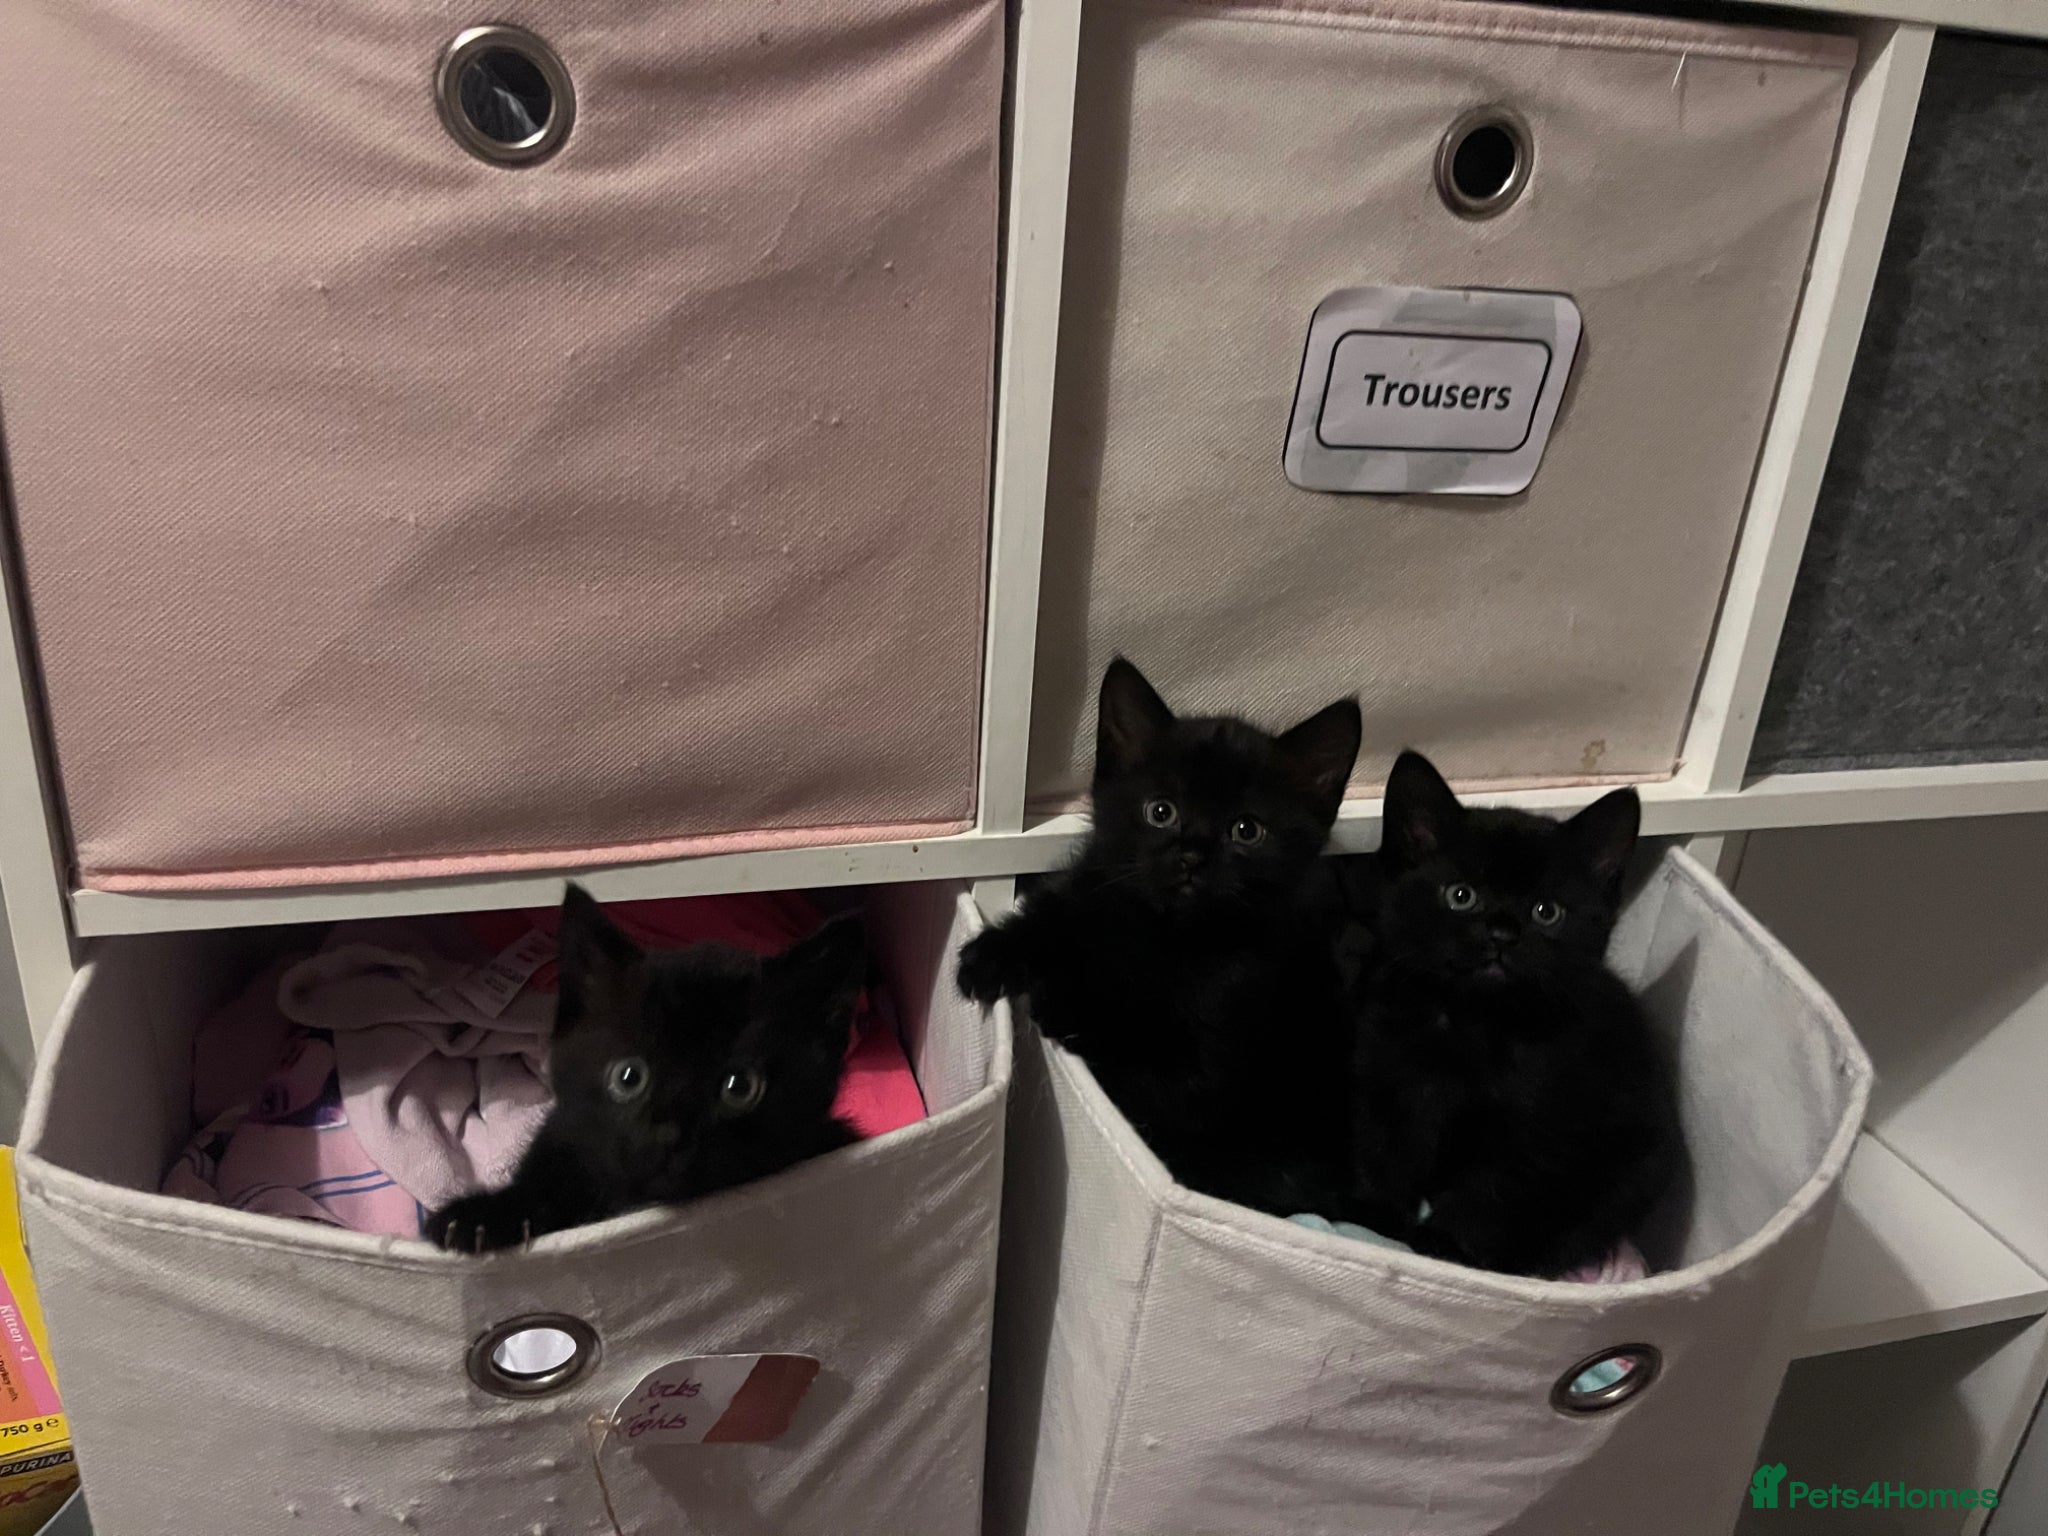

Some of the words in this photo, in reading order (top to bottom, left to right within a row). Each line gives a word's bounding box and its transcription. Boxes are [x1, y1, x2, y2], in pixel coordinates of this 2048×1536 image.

[1363, 373, 1513, 411] Trousers
[0, 1304, 24, 1343] Kitten
[0, 1424, 29, 1438] 750
[33, 1423, 44, 1432] g
[0, 1453, 72, 1476] PURINA
